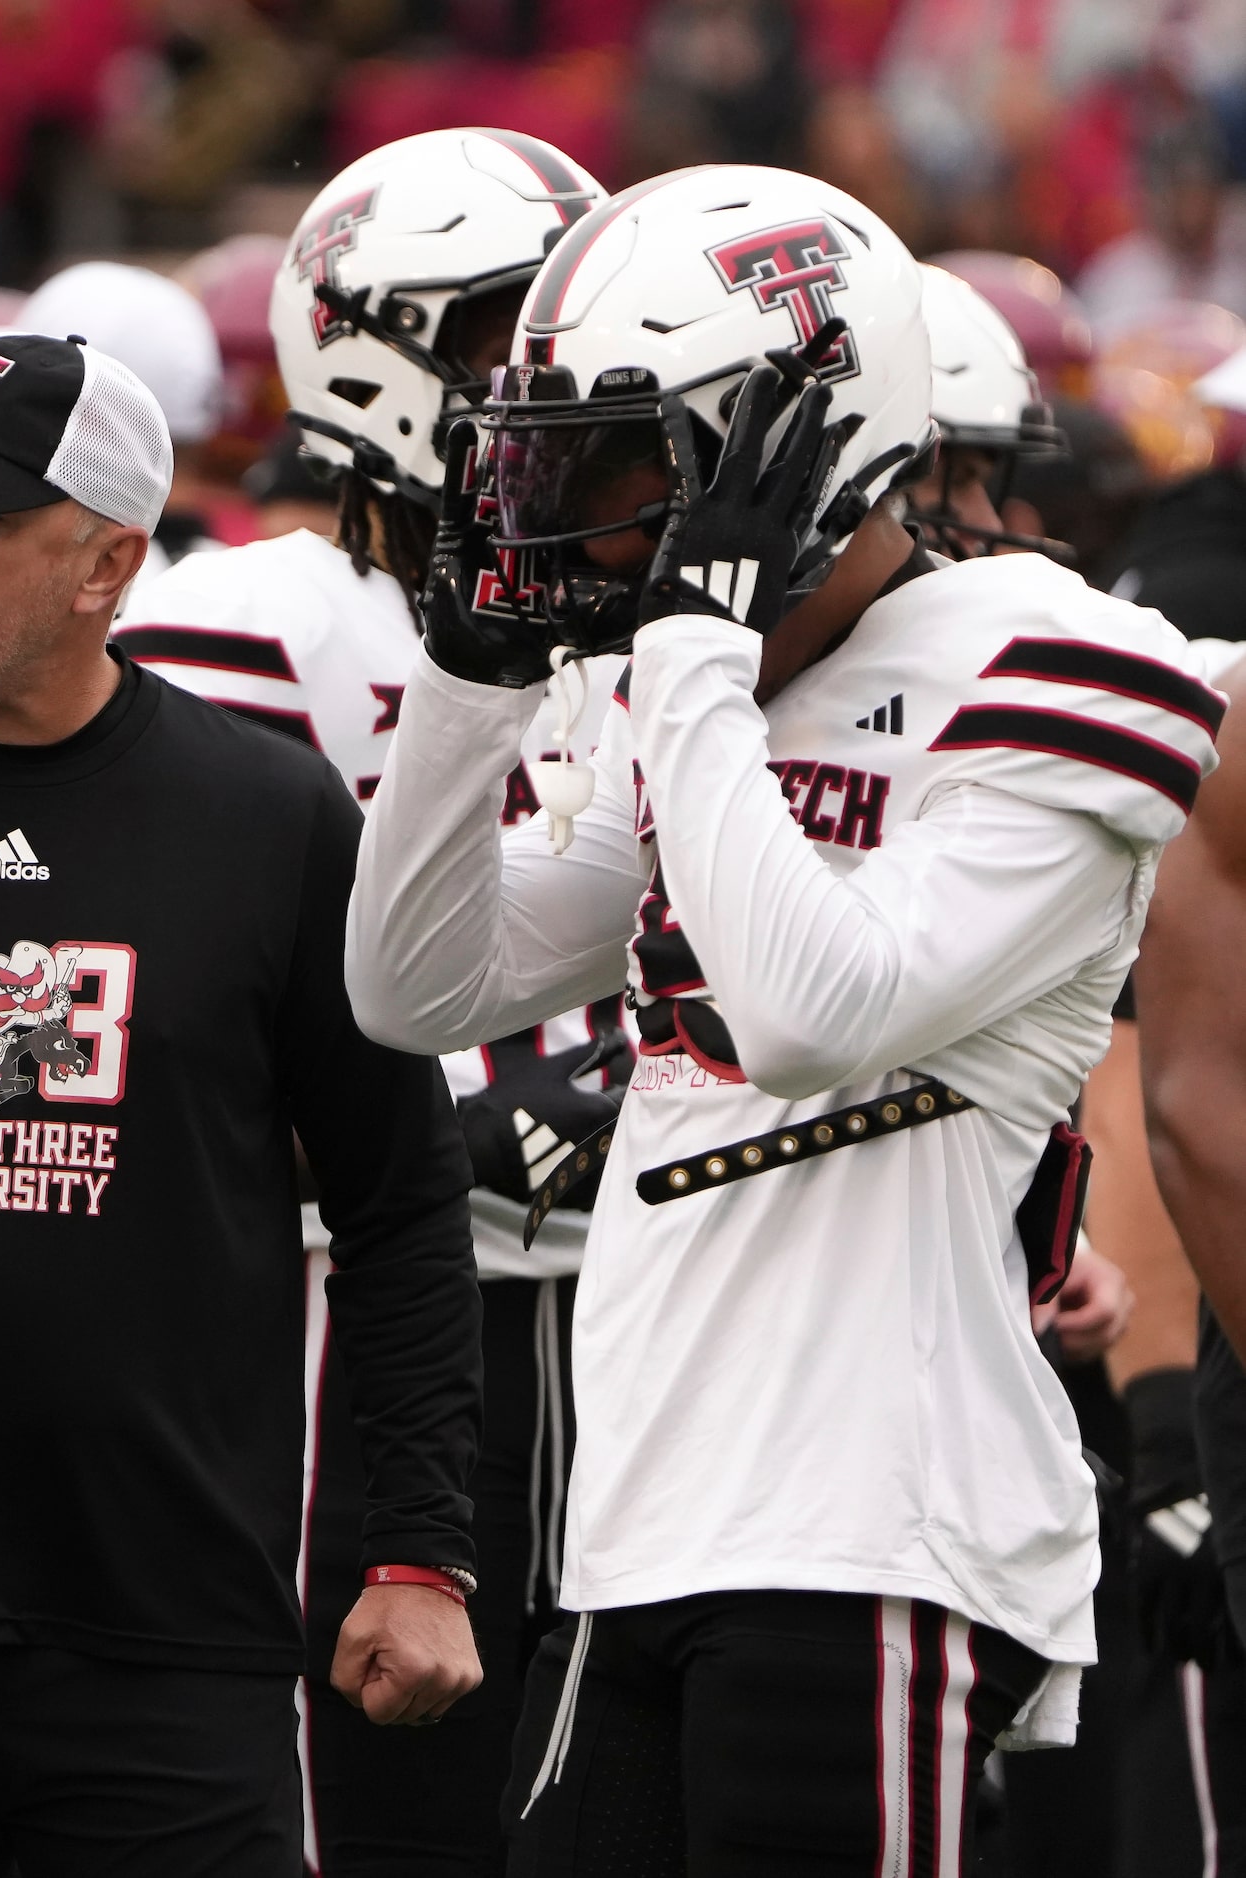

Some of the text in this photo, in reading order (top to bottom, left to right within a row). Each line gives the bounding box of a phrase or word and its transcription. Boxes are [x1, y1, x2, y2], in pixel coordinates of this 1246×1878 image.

[601, 369, 648, 385] GUNS UP
[37, 940, 138, 1106] 3
